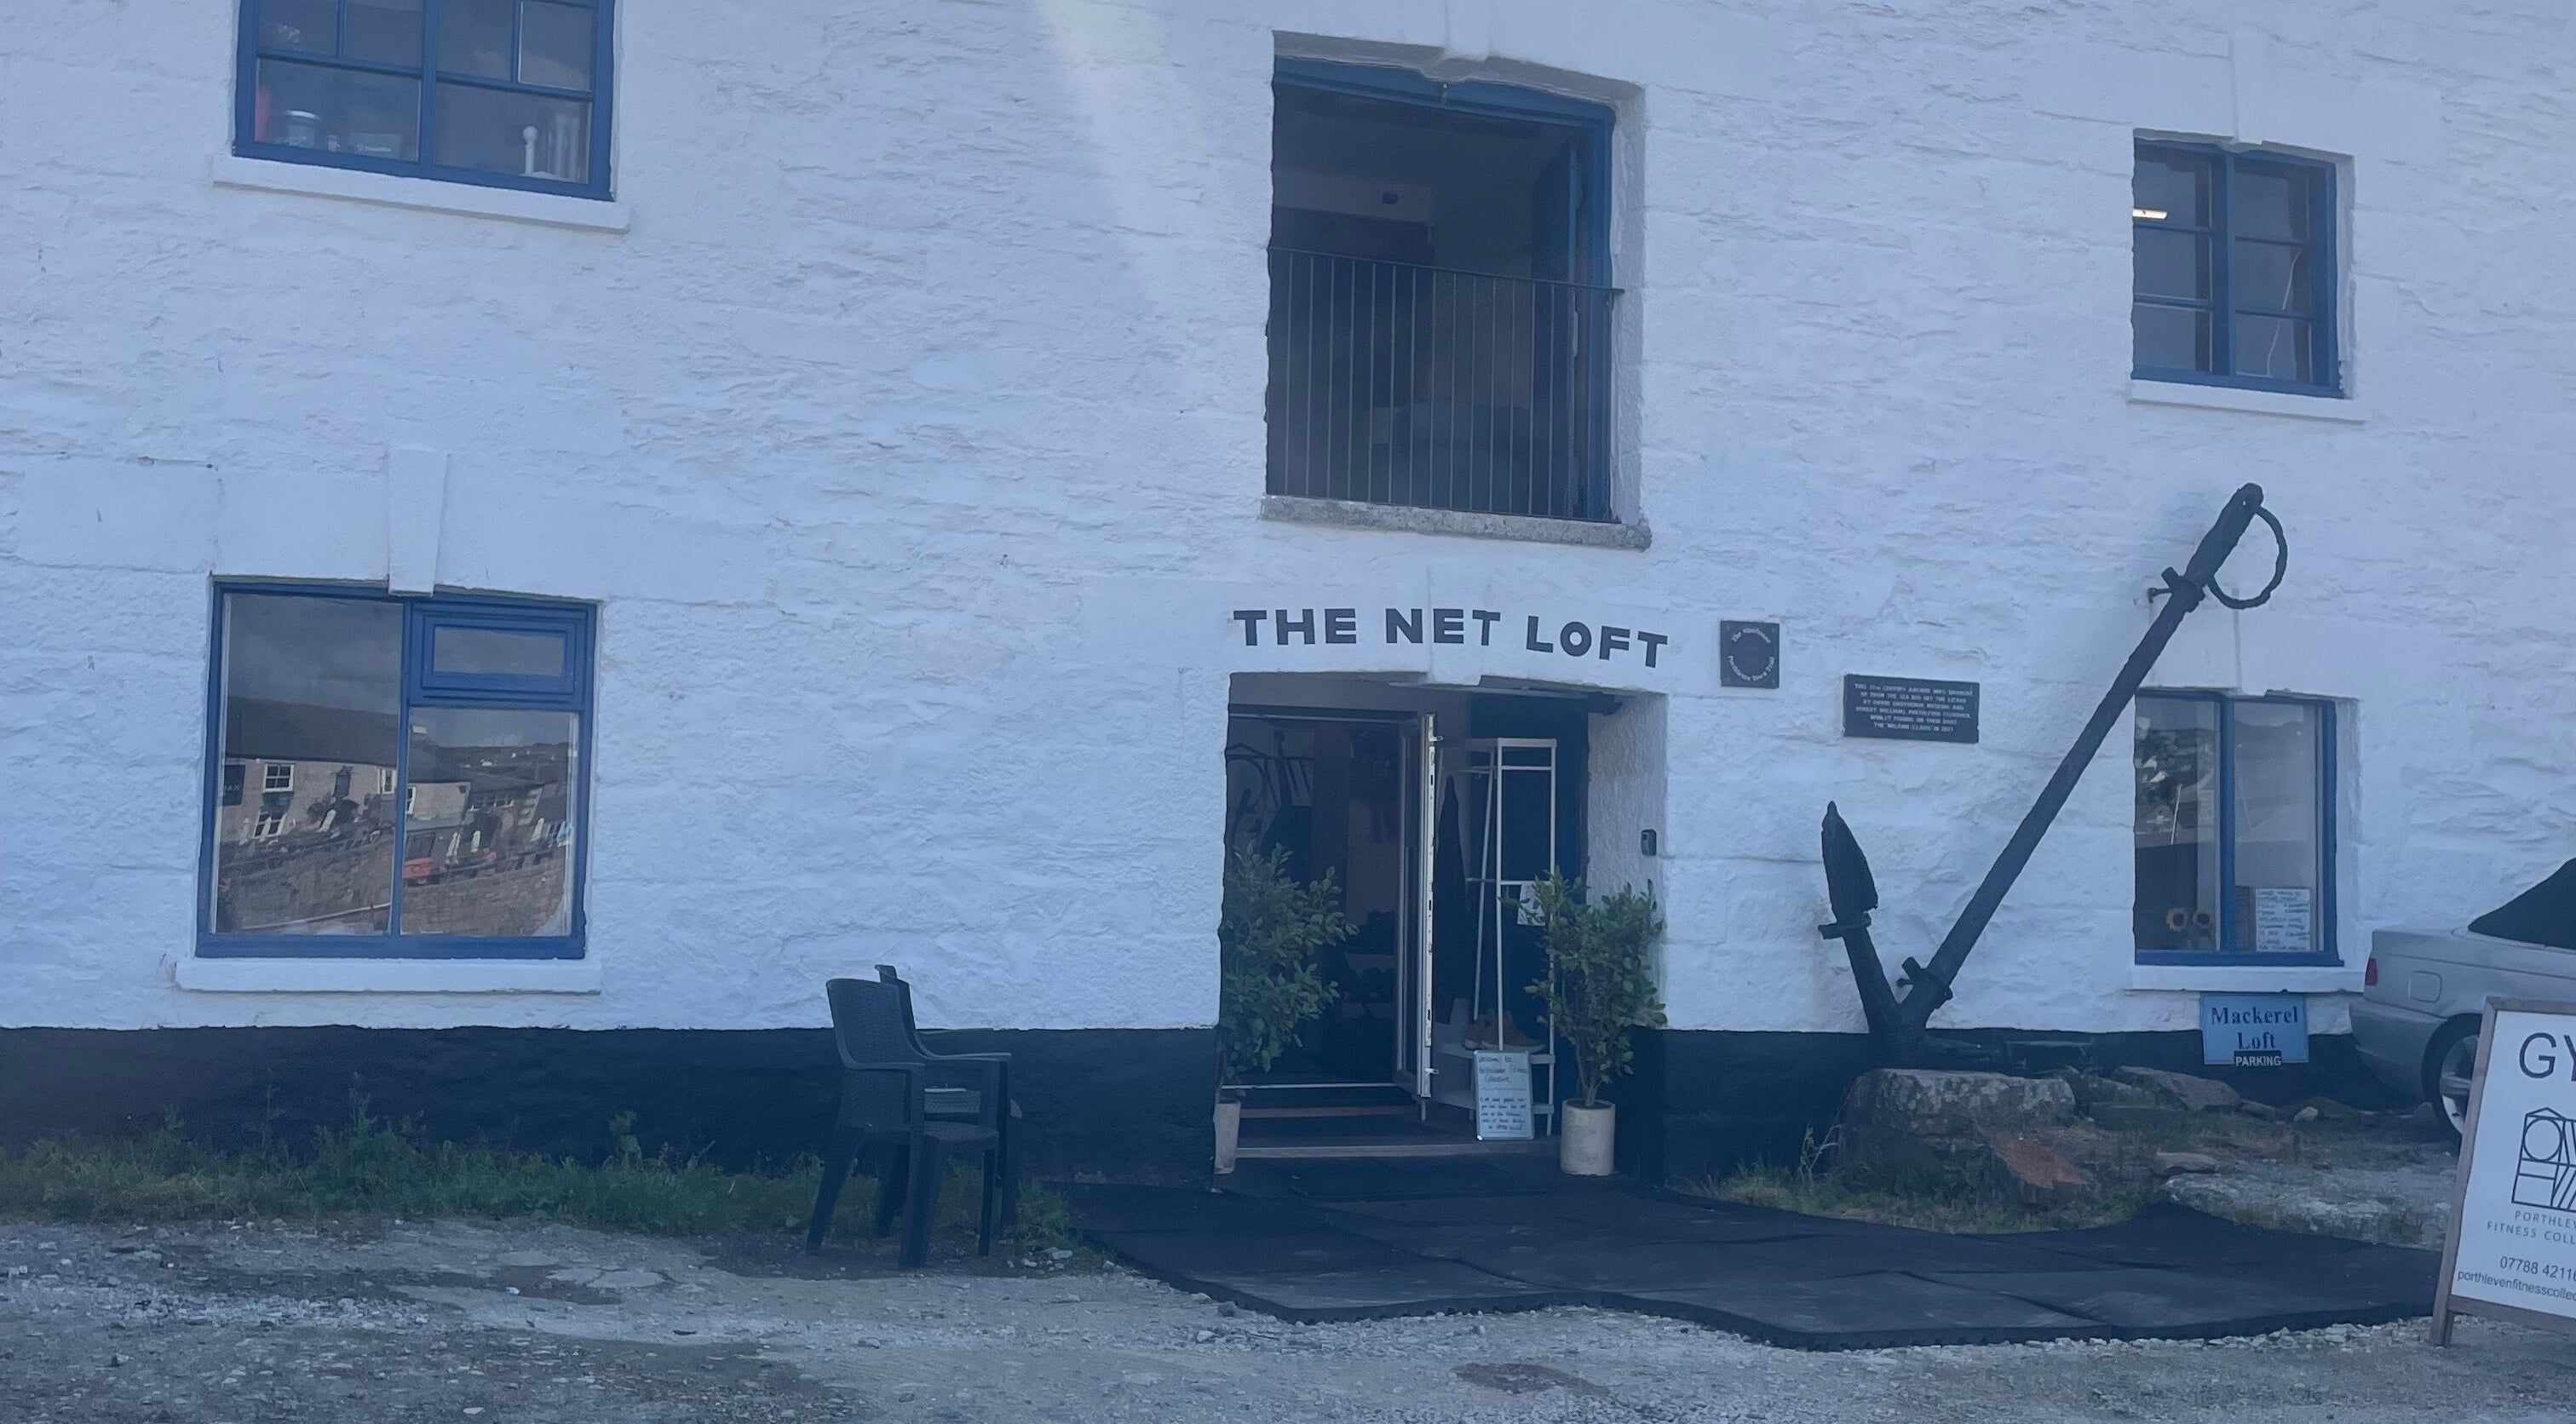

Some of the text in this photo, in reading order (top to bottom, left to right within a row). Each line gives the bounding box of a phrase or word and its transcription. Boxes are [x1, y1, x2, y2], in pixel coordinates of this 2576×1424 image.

[1233, 608, 1669, 669] THE NET LOFT
[2211, 1006, 2298, 1025] Mackerel
[2237, 1031, 2276, 1050] Loft
[2235, 1055, 2282, 1066] PARKING
[2487, 1220, 2538, 1238] FITNESS
[2500, 1256, 2539, 1275] 07788
